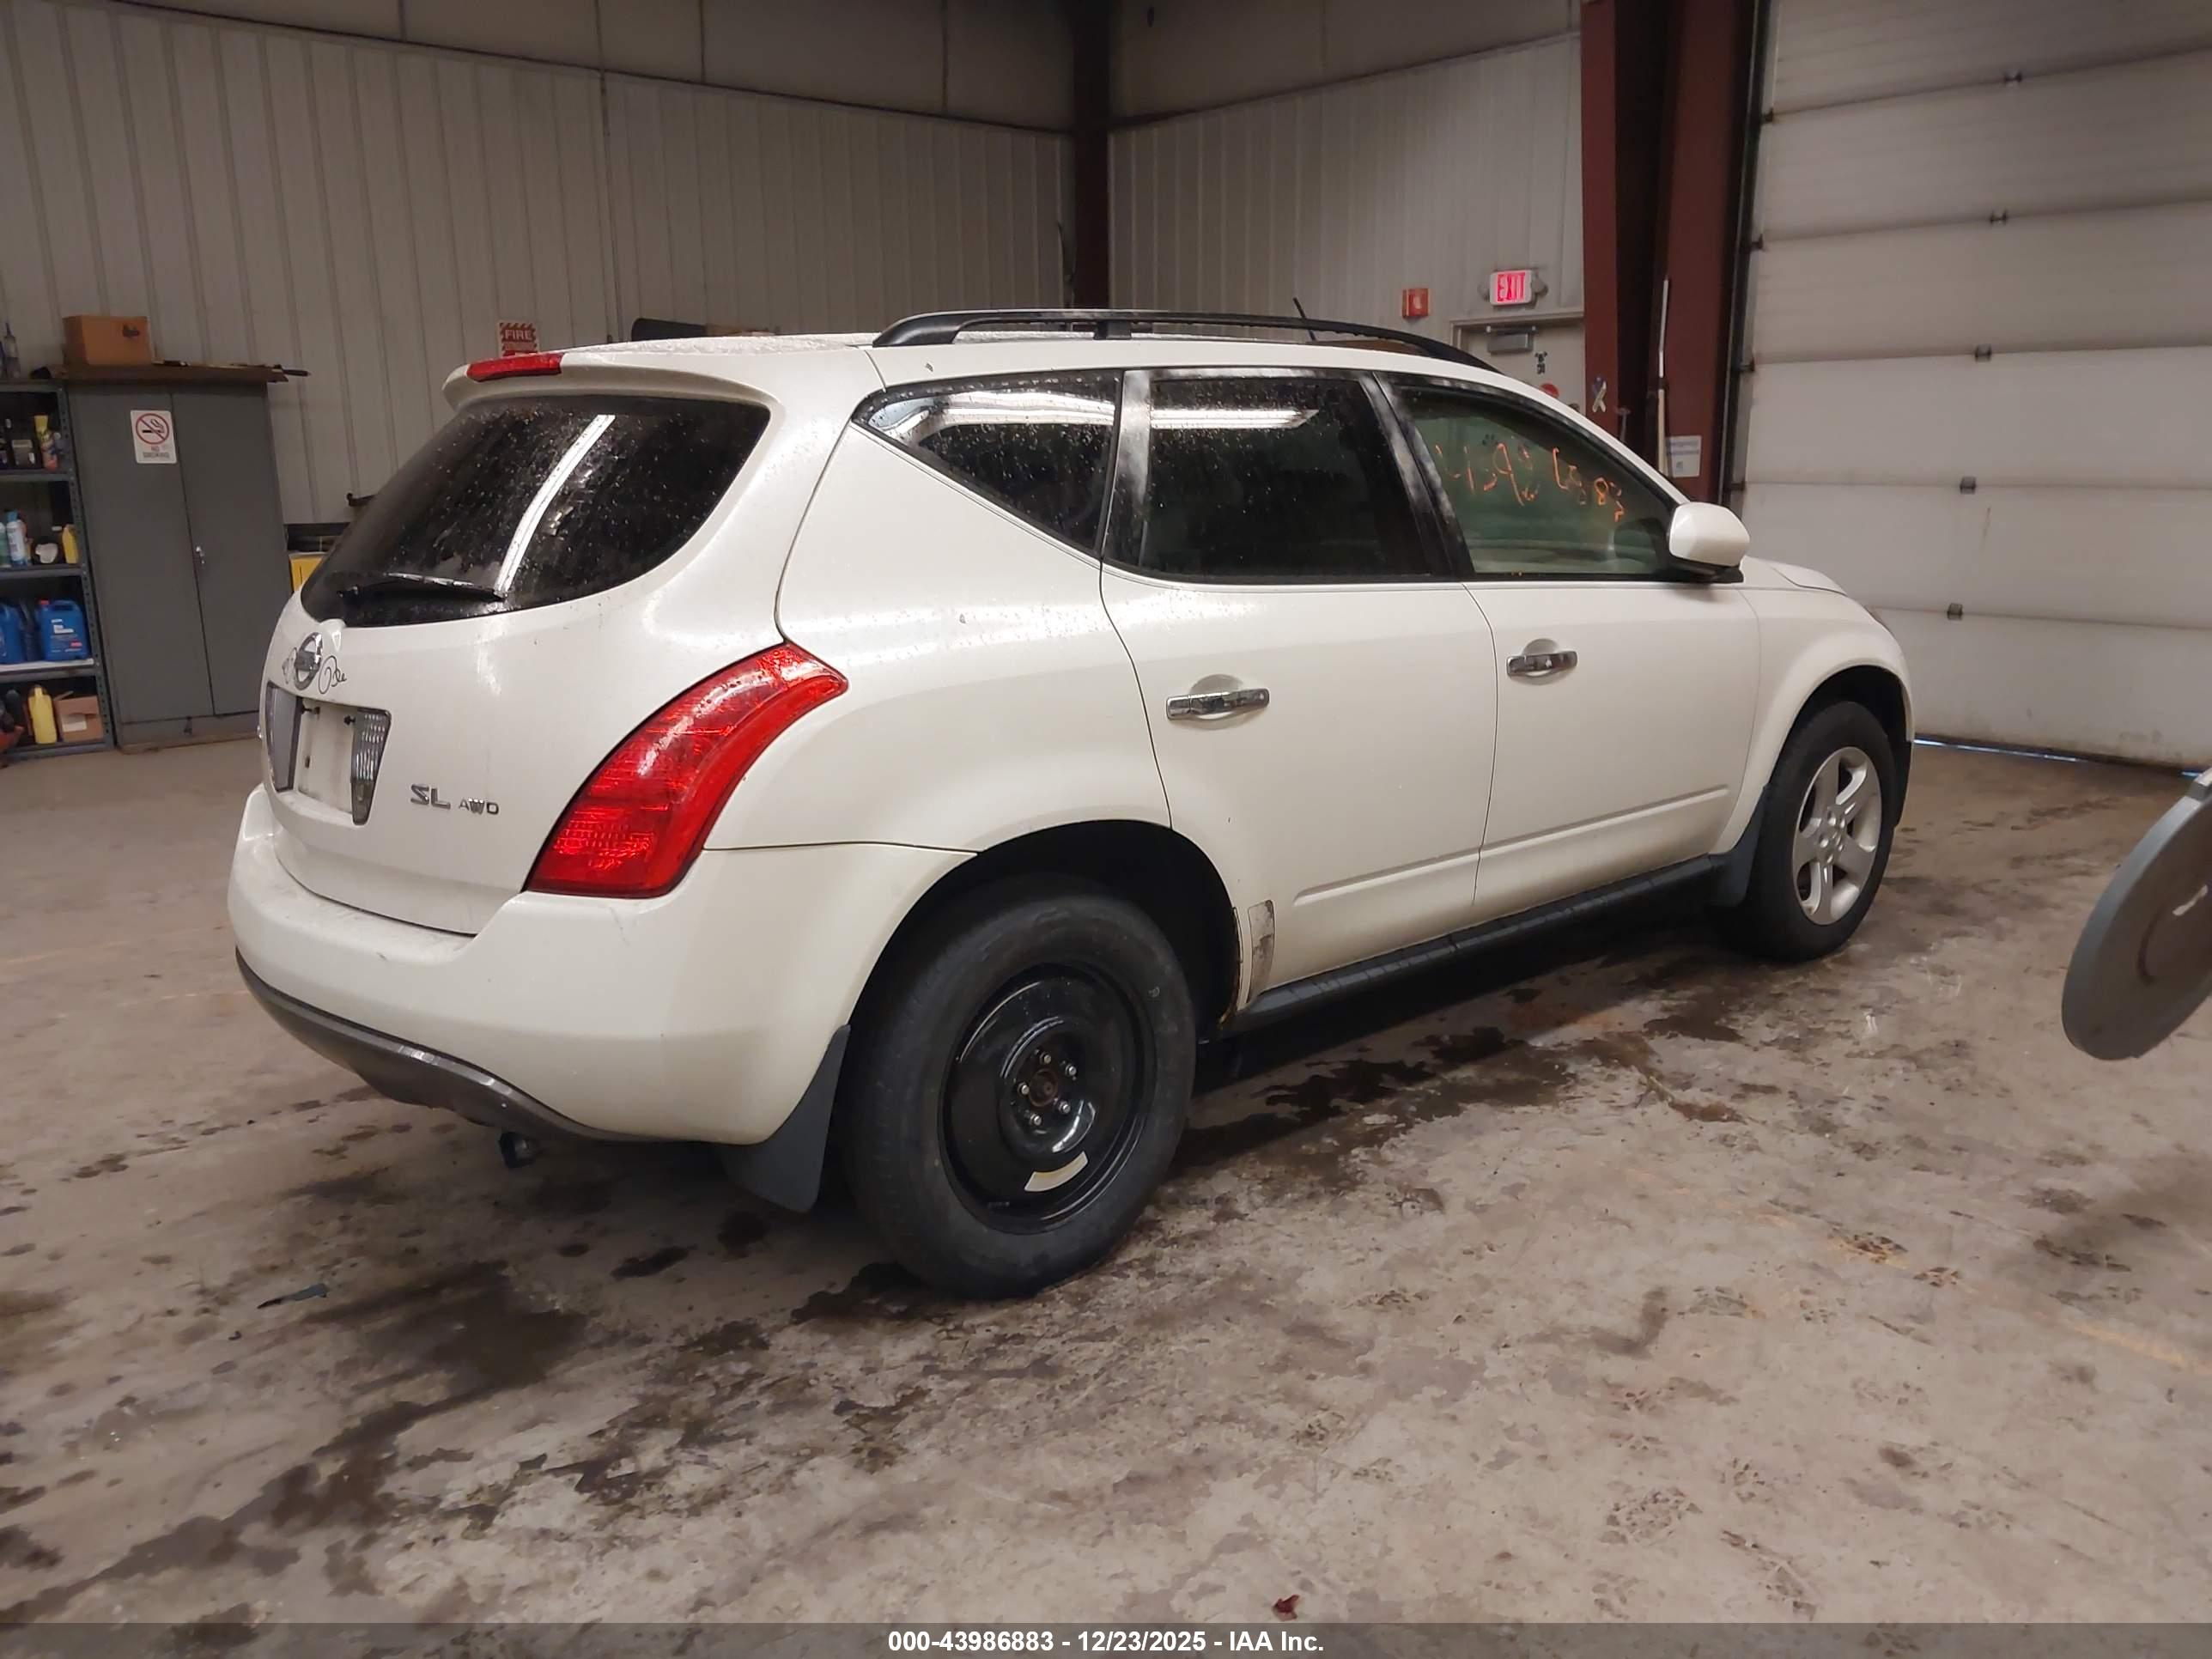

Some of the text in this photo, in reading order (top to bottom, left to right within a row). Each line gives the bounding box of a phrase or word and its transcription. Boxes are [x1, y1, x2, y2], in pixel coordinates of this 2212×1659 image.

[1497, 272, 1525, 302] EXIT
[505, 329, 533, 340] FIRE
[410, 784, 499, 815] SL AWD
